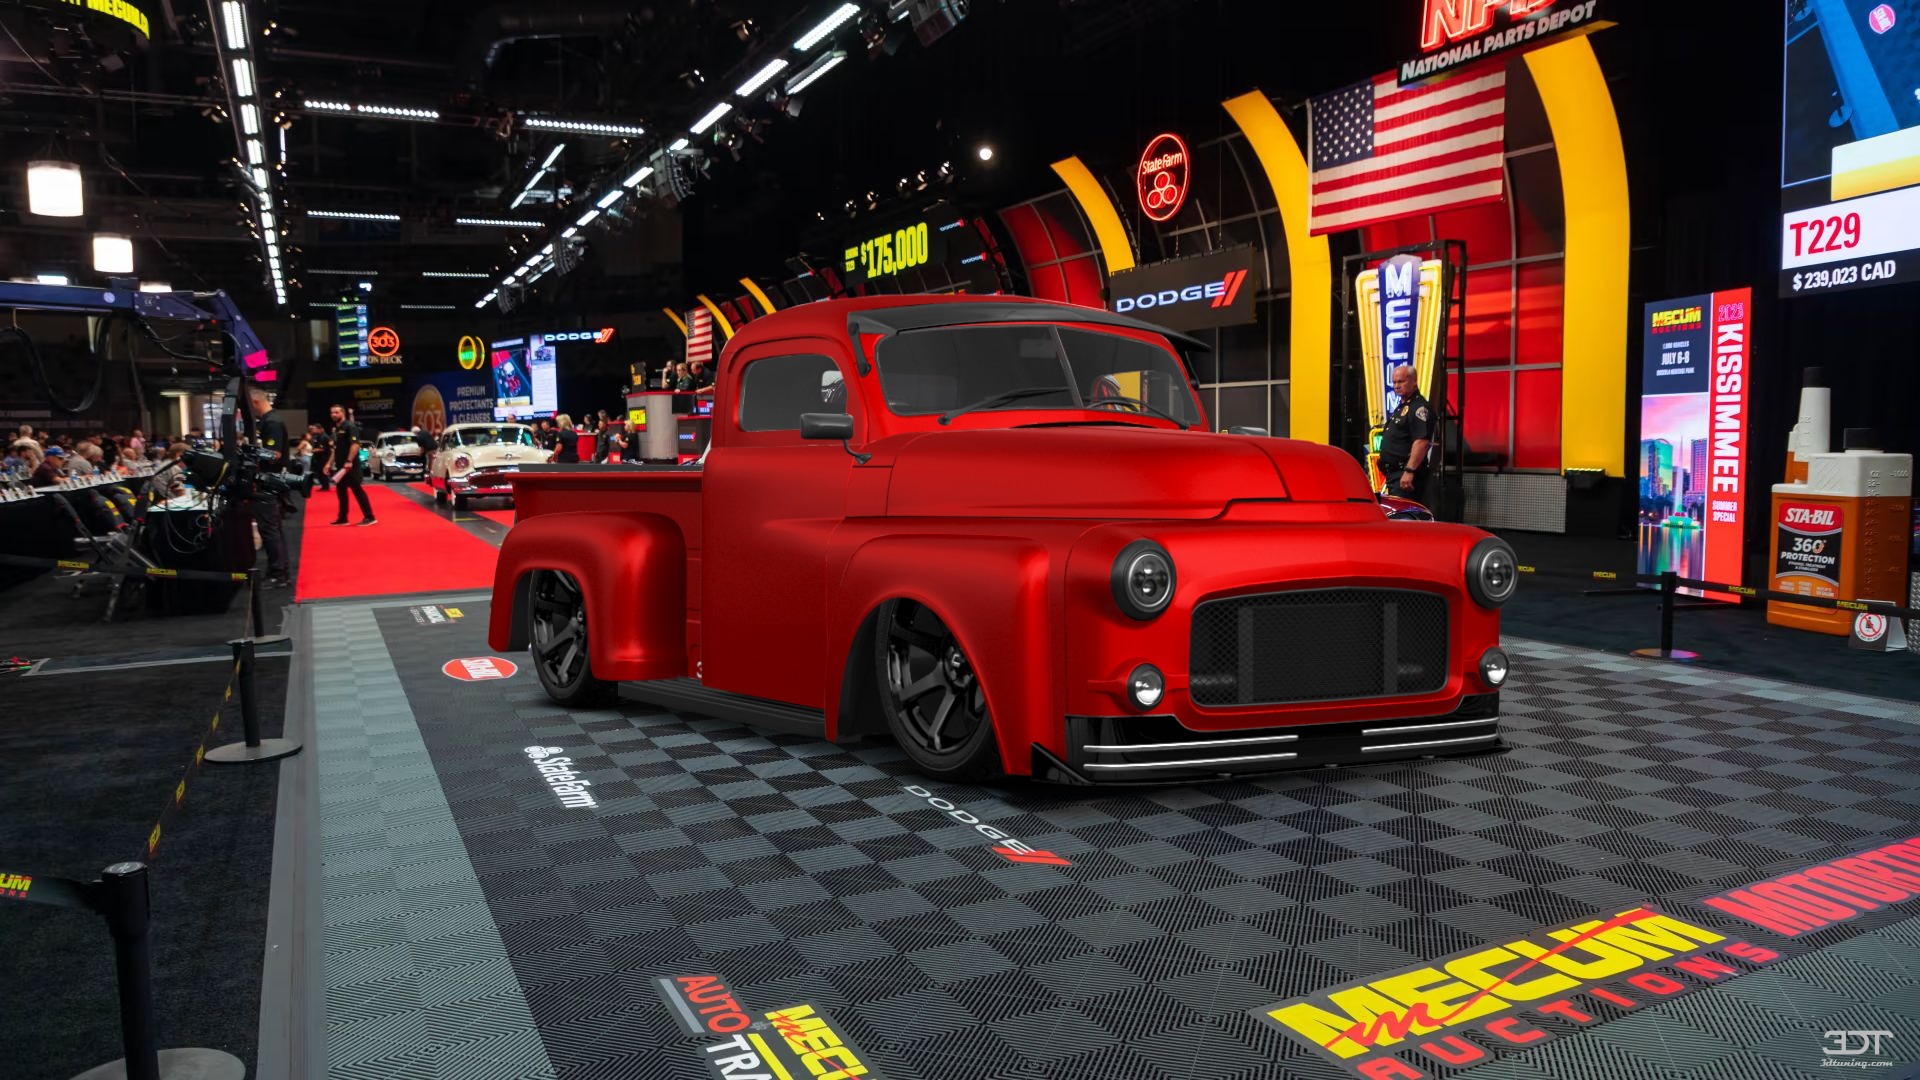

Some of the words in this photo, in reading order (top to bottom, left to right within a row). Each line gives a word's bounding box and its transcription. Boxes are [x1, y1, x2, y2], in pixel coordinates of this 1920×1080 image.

[1421, 0, 1556, 52] NP
[1400, 44, 1482, 82] NATIONAL
[1483, 21, 1536, 54] PARTS
[1537, 1, 1597, 36] DEPOT
[1789, 212, 1861, 257] T229
[861, 222, 928, 279] $175,000
[1861, 260, 1896, 281] CAD
[1116, 281, 1226, 313] DODGE
[1652, 307, 1702, 328] MECUM
[544, 331, 603, 342] DODGE
[1661, 352, 1677, 366] JULY
[1677, 351, 1690, 364] 6-8
[456, 386, 487, 397] PREMIUM
[449, 398, 495, 412] PROTECTANTS
[458, 412, 491, 424] CLEANERS
[1712, 323, 1744, 494] KISSIMMEE
[1785, 507, 1835, 526] STA-BIL
[1781, 551, 1836, 565] PROTECTION
[1728, 585, 1757, 596] MECUM
[1836, 600, 1868, 611] MECUM
[903, 785, 1037, 856] DODGE
[1266, 907, 1727, 1059] MECUM
[677, 976, 751, 1033] AUTO
[1355, 944, 1780, 1080] AUCTIONS
[706, 1034, 773, 1080] TR
